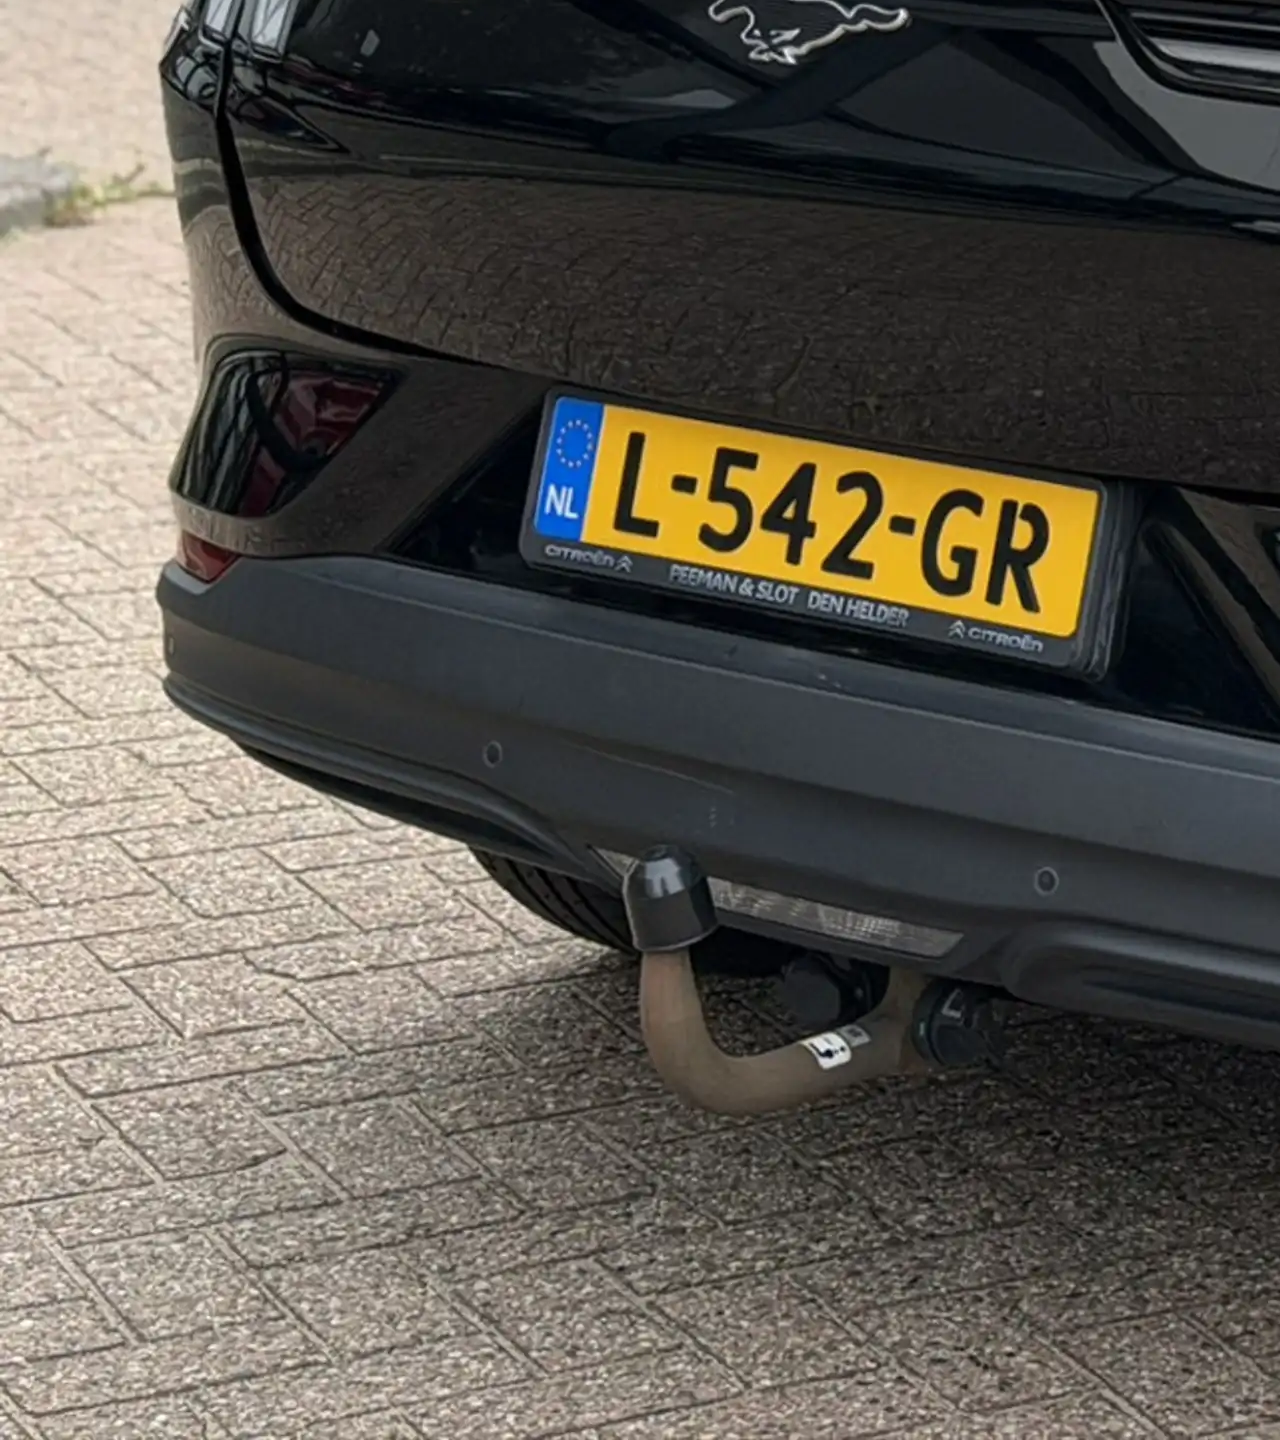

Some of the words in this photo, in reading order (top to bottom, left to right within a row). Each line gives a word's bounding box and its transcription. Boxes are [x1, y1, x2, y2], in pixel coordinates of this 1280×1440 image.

[544, 483, 580, 520] NL
[612, 431, 1050, 614] L-542-GR
[738, 577, 756, 597] &
[756, 581, 800, 605] SLOT
[807, 590, 845, 614] DEN
[846, 599, 911, 628] HELDER
